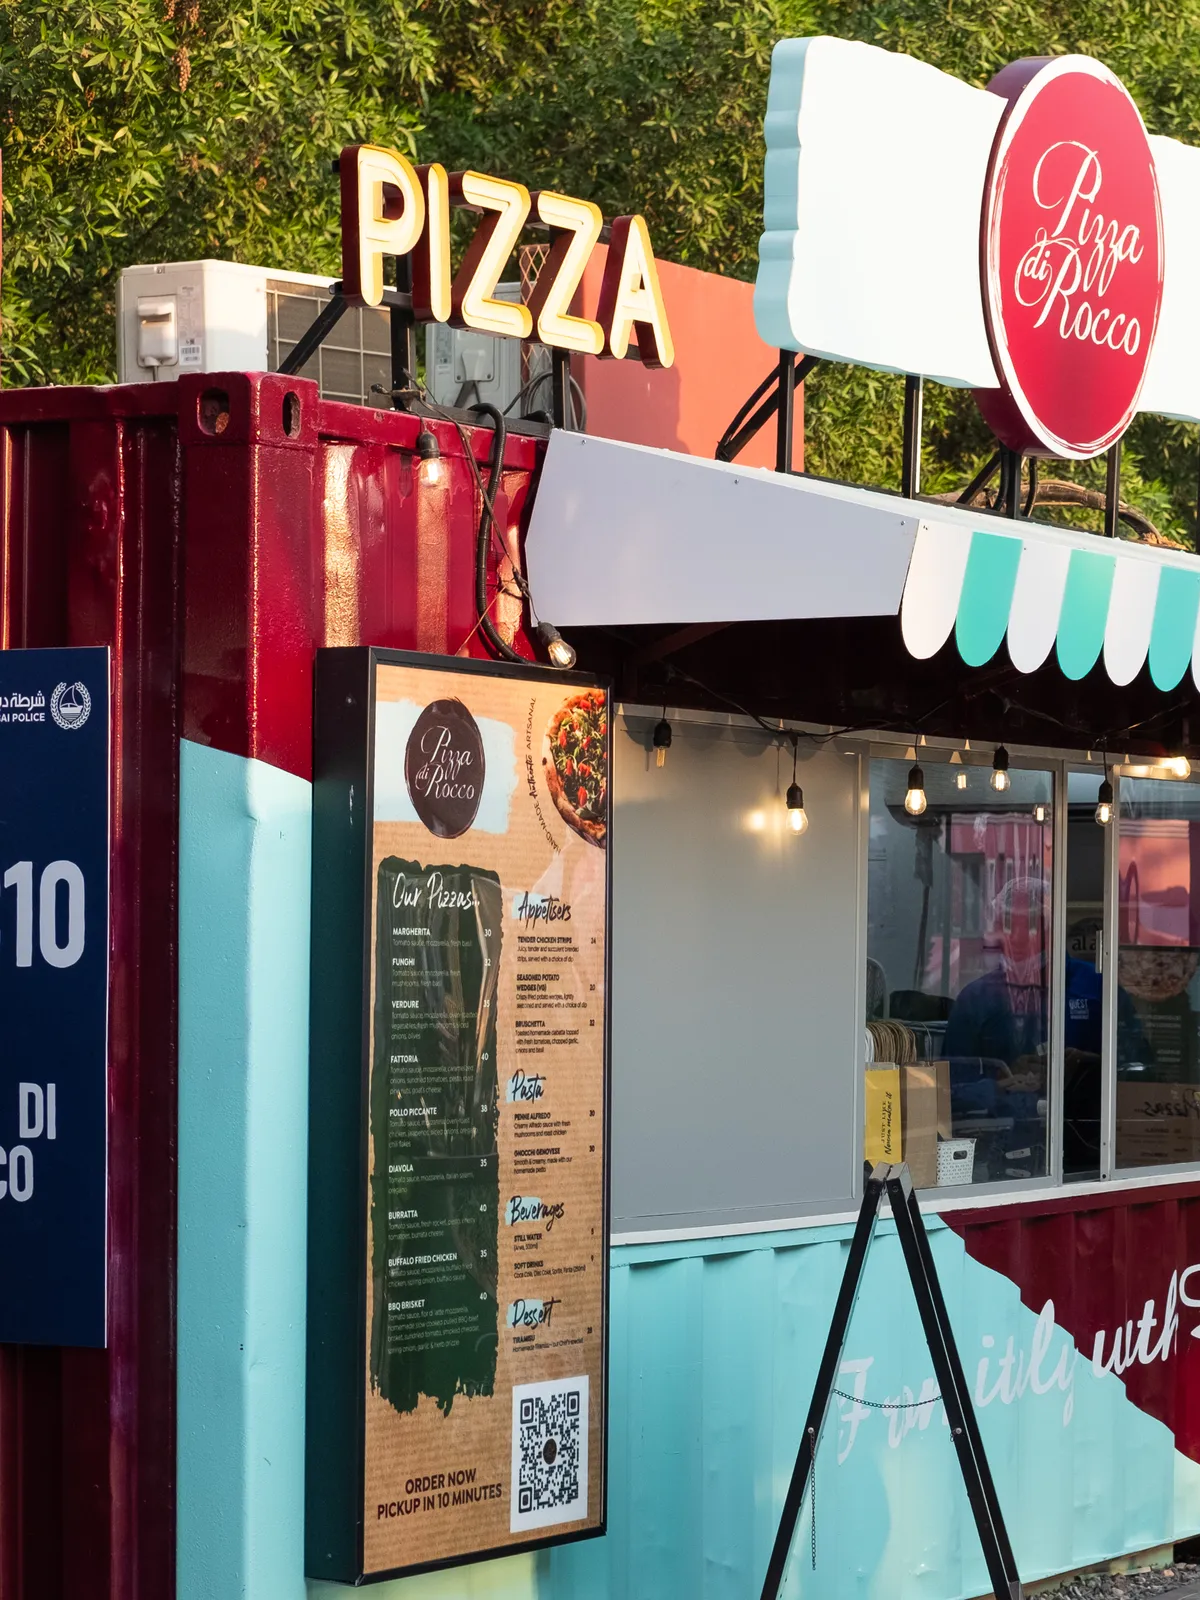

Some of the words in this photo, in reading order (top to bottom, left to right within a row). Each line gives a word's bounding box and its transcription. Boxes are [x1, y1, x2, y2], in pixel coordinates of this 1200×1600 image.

[1032, 140, 1144, 297] Pizza
[341, 144, 675, 369] PIZZA
[1020, 226, 1052, 281] di
[1017, 238, 1141, 355] Rocco
[12, 713, 46, 722] POLICE
[420, 725, 474, 781] Pizza
[415, 763, 475, 800] Rocco
[392, 872, 422, 908] Our
[518, 890, 572, 930] Appetisers
[392, 927, 431, 936] MARGHERITA
[484, 929, 492, 937] 30
[517, 936, 536, 944] TENDER
[536, 936, 557, 944] CHICKEN
[392, 958, 415, 966] FUNGHI
[516, 984, 537, 992] WEDGES
[391, 1000, 420, 1009] VERDURE
[483, 1000, 490, 1008] 35
[515, 1020, 546, 1028] BRUSCHETTA
[390, 1055, 419, 1063] FATTORIA
[481, 1052, 489, 1061] 40
[511, 1068, 547, 1105] Pasta
[19, 1082, 56, 1140] DI
[389, 1108, 409, 1117] POLLO
[409, 1107, 437, 1116] PICCANTE
[514, 1113, 530, 1121] PENNE
[529, 1112, 552, 1120] ALFREDO
[514, 1149, 536, 1157] GNOCCHI
[388, 1164, 414, 1173] DIAVOLA
[480, 1159, 488, 1167] 35
[388, 1210, 418, 1220] BURRATTA
[479, 1204, 487, 1212] 40
[510, 1195, 565, 1232] Beverages
[388, 1256, 415, 1267] BUFFALO
[415, 1254, 432, 1265] FRIED
[432, 1252, 458, 1263] CHICKEN
[480, 1249, 487, 1258] 35
[514, 1262, 527, 1270] SOFT
[388, 1302, 401, 1312] BBQ
[401, 1299, 426, 1309] BRISKET
[479, 1292, 488, 1301] 40
[512, 1296, 562, 1330] Dessert
[404, 1474, 445, 1495] ORDER
[449, 1467, 477, 1488] NOW
[377, 1498, 420, 1521] PICKUP
[423, 1496, 435, 1512] IN
[437, 1493, 449, 1509] 10
[451, 1483, 502, 1507] MINUTES
